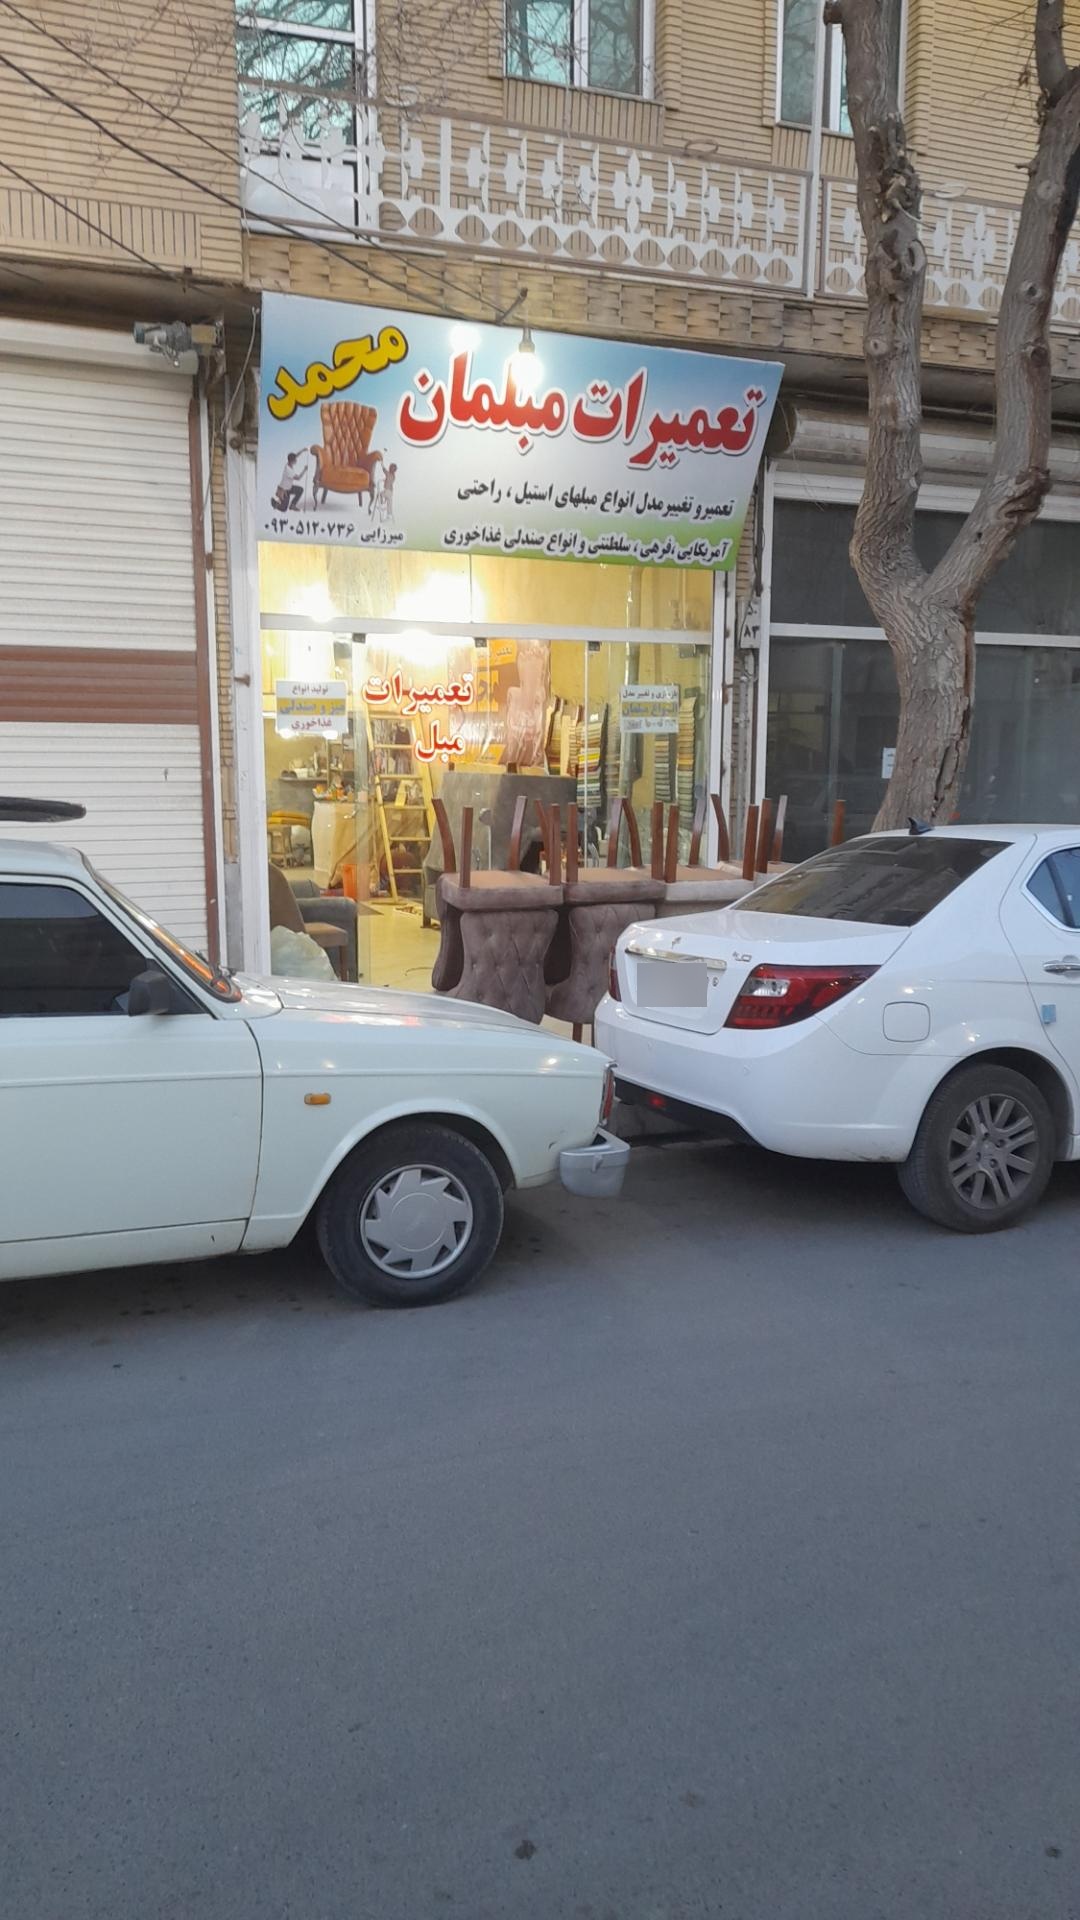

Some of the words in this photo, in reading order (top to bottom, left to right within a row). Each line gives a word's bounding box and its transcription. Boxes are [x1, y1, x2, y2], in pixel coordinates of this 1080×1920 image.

[267, 325, 409, 421] محمد
[399, 350, 567, 452] مبلمان
[572, 368, 764, 467] تعمیرات
[457, 477, 502, 503] راحتی
[554, 484, 598, 509] مبلهای
[599, 488, 636, 514] انواع
[635, 491, 664, 515] مدل
[661, 495, 695, 517] تغییر
[692, 500, 703, 520] و
[700, 499, 735, 520] تعمیر
[264, 517, 355, 538] ۰۹۳۰۵۱۲۰۷۳۶
[360, 526, 404, 544] میرزایی
[503, 528, 545, 549] صندلی
[546, 532, 578, 553] انواع
[579, 539, 586, 554] و
[588, 536, 632, 555] سلطنتی
[291, 683, 310, 696] انواع
[362, 670, 473, 716] تعمیرات
[291, 718, 333, 730] غذاخوری
[415, 719, 465, 762] مبل
